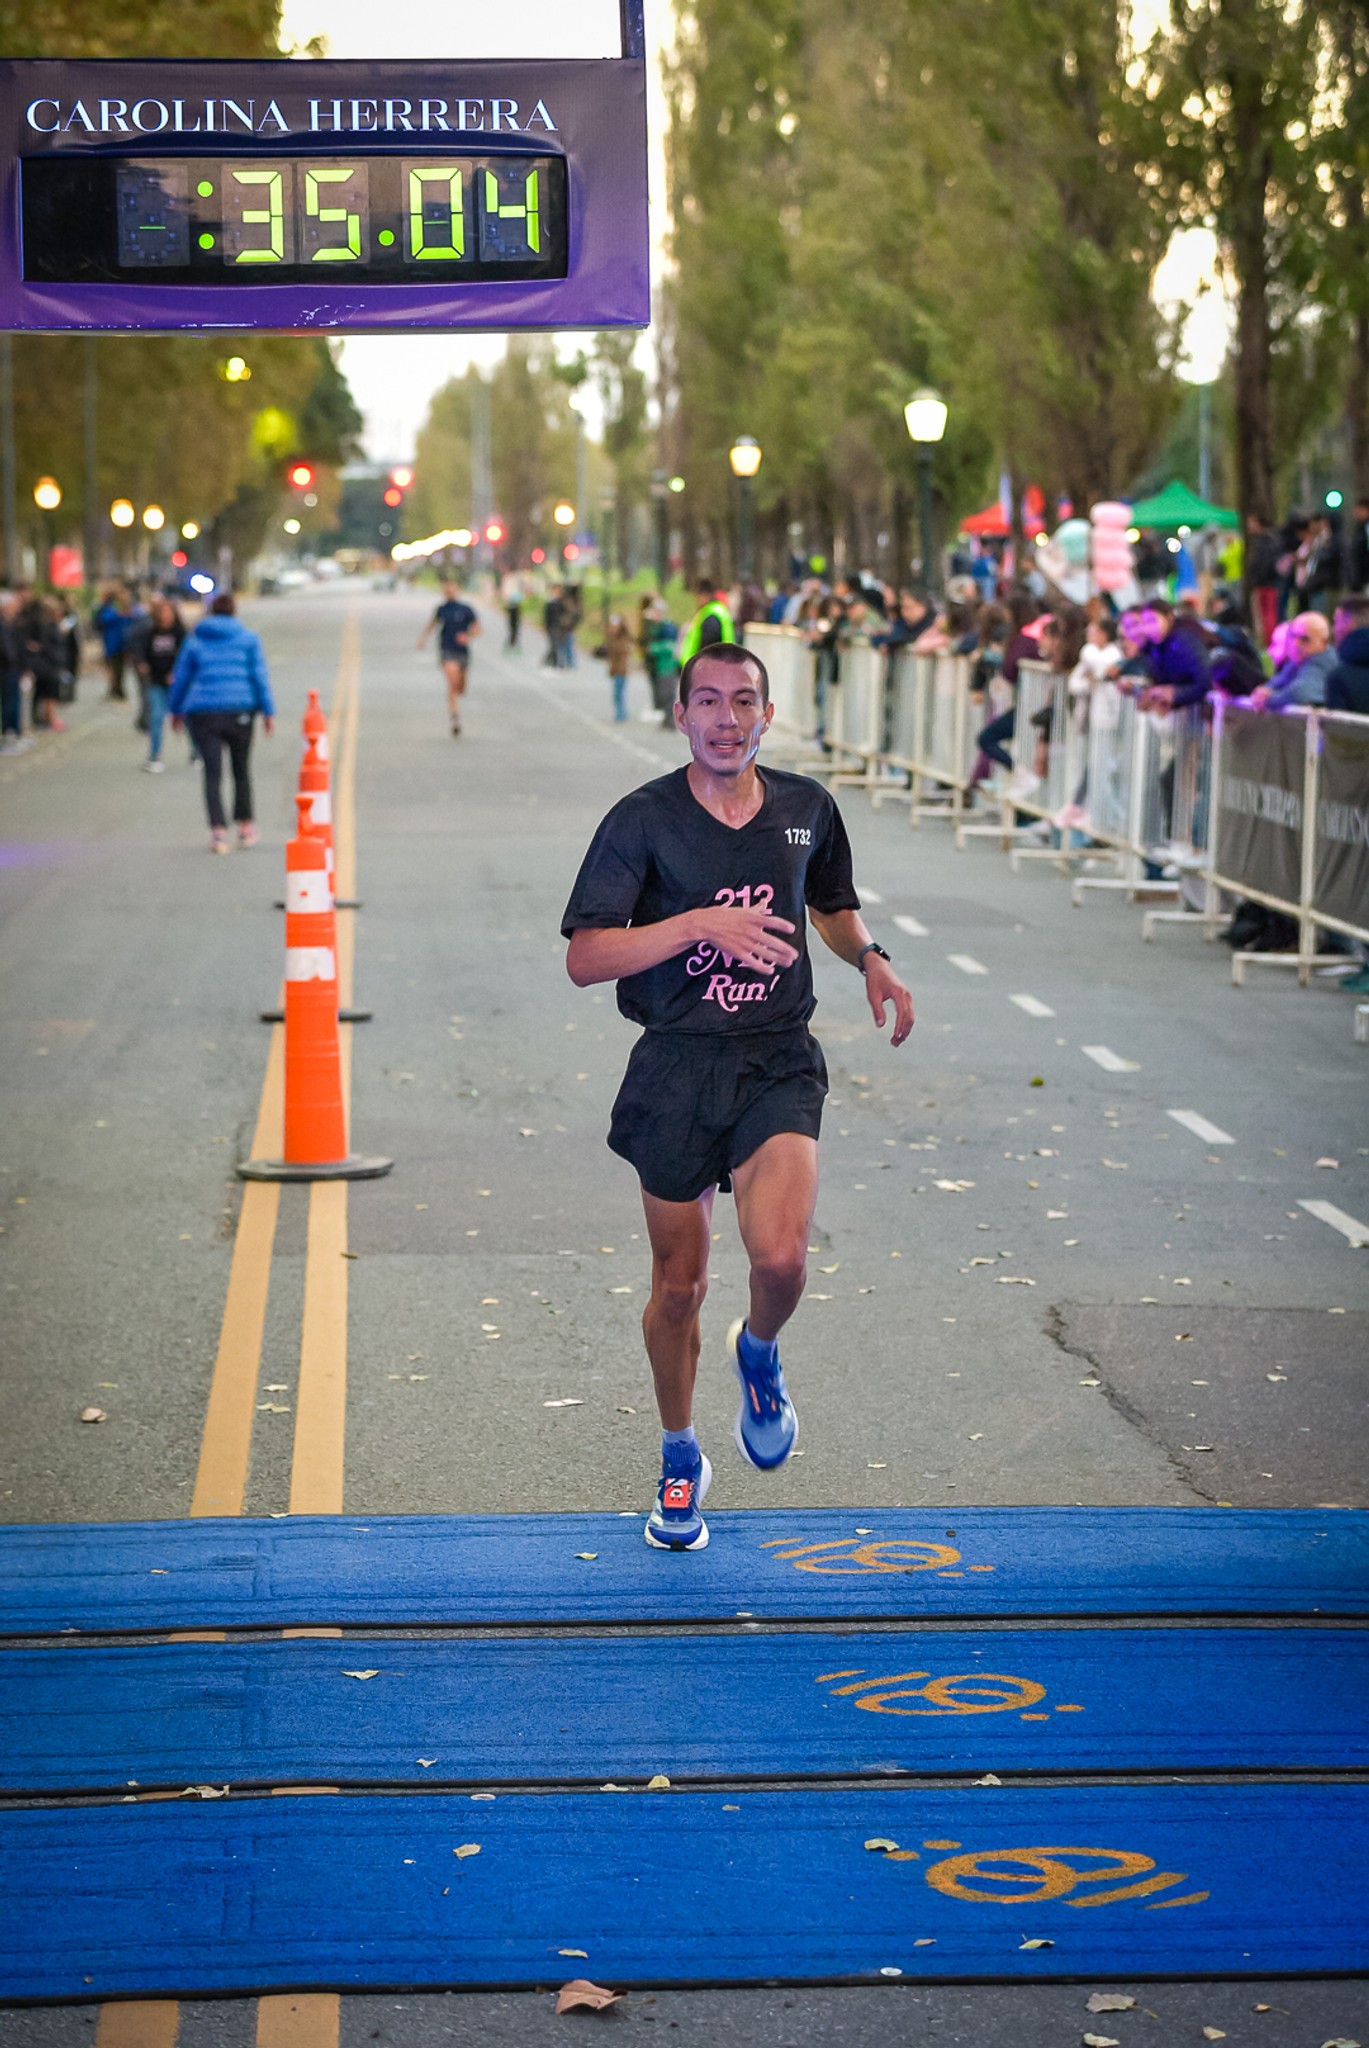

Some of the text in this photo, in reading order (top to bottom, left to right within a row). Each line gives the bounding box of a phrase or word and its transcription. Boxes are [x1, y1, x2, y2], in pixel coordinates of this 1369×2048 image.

[26, 97, 559, 133] CAROLINA HERRERA
[784, 827, 812, 846] 1732
[714, 883, 775, 916] 212
[701, 974, 781, 1013] Run!
